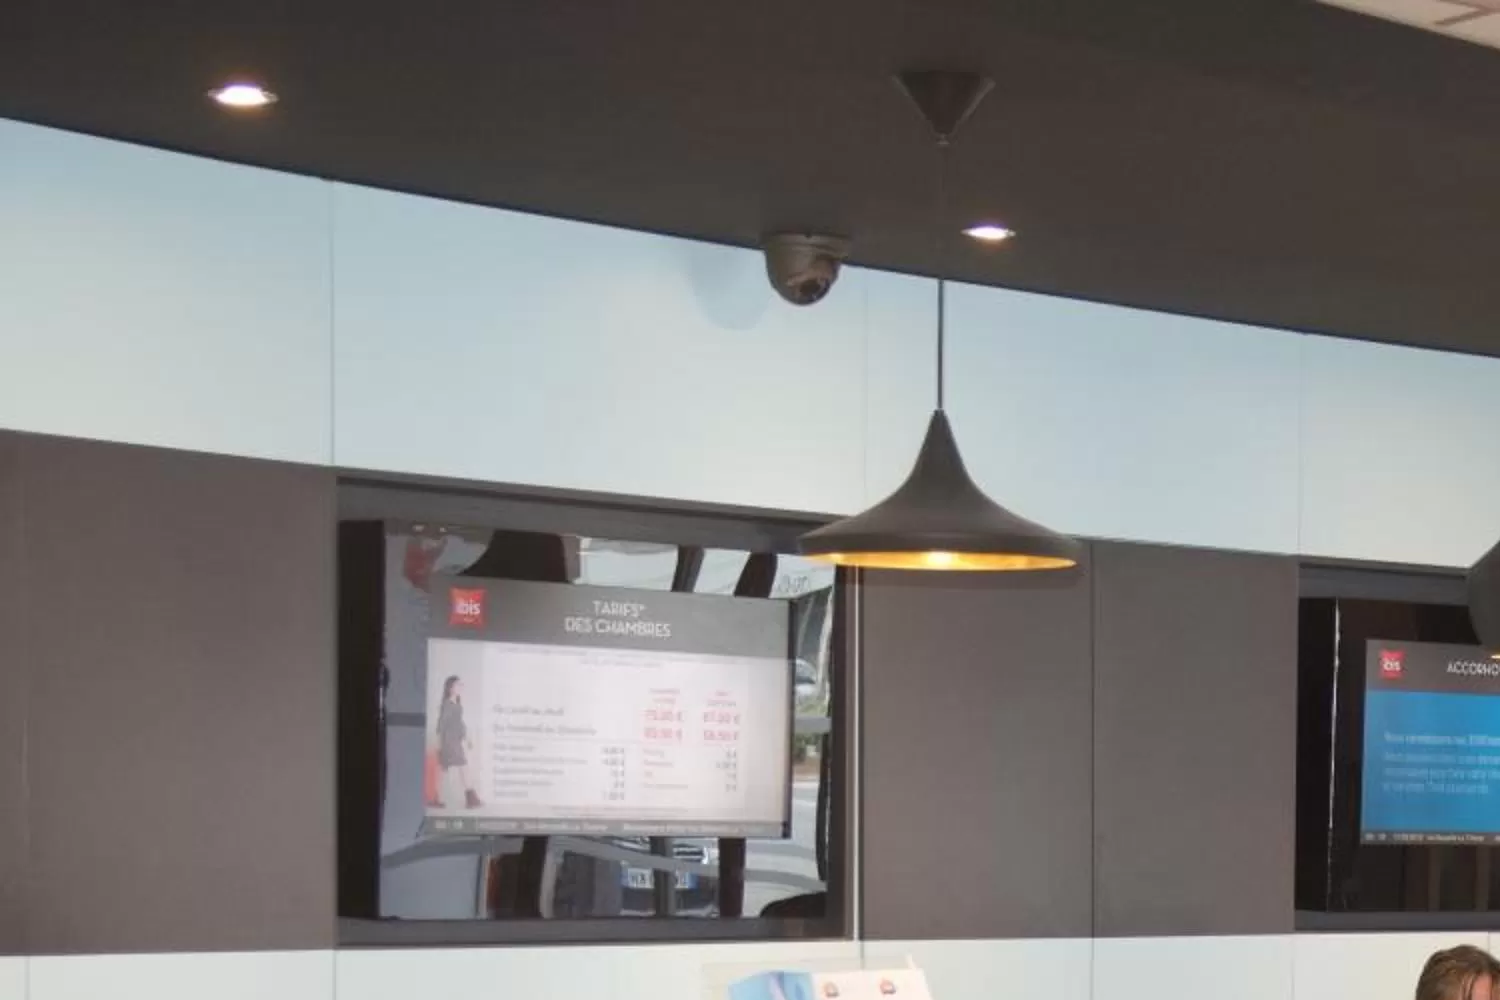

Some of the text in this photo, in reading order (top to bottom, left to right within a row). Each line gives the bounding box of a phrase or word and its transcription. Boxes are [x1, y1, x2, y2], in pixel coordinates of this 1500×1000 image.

[455, 597, 481, 615] ibis
[564, 616, 672, 637] DES CHAMBRES
